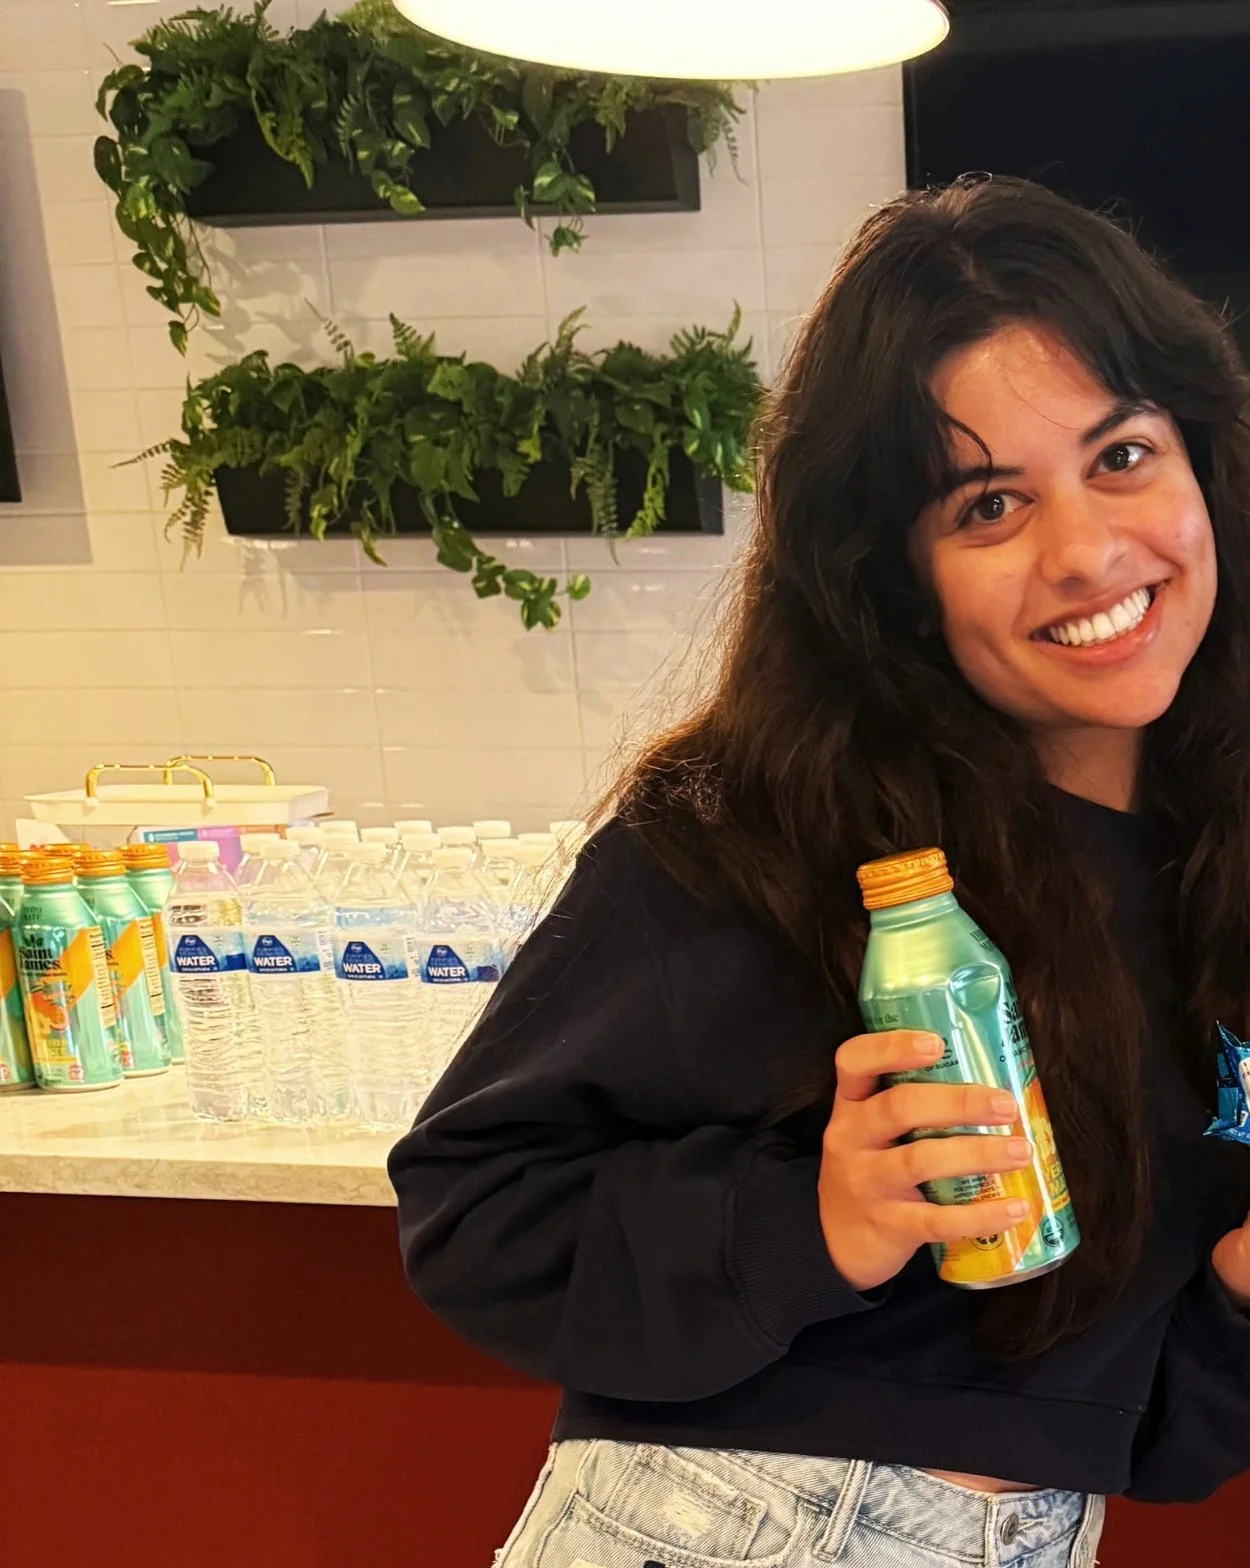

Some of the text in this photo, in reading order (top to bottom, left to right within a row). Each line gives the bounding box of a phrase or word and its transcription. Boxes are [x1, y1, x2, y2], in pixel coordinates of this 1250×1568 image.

[176, 956, 216, 967] WATER
[254, 956, 293, 967] WATER
[343, 962, 381, 974] WATER
[428, 966, 466, 978] WATER
